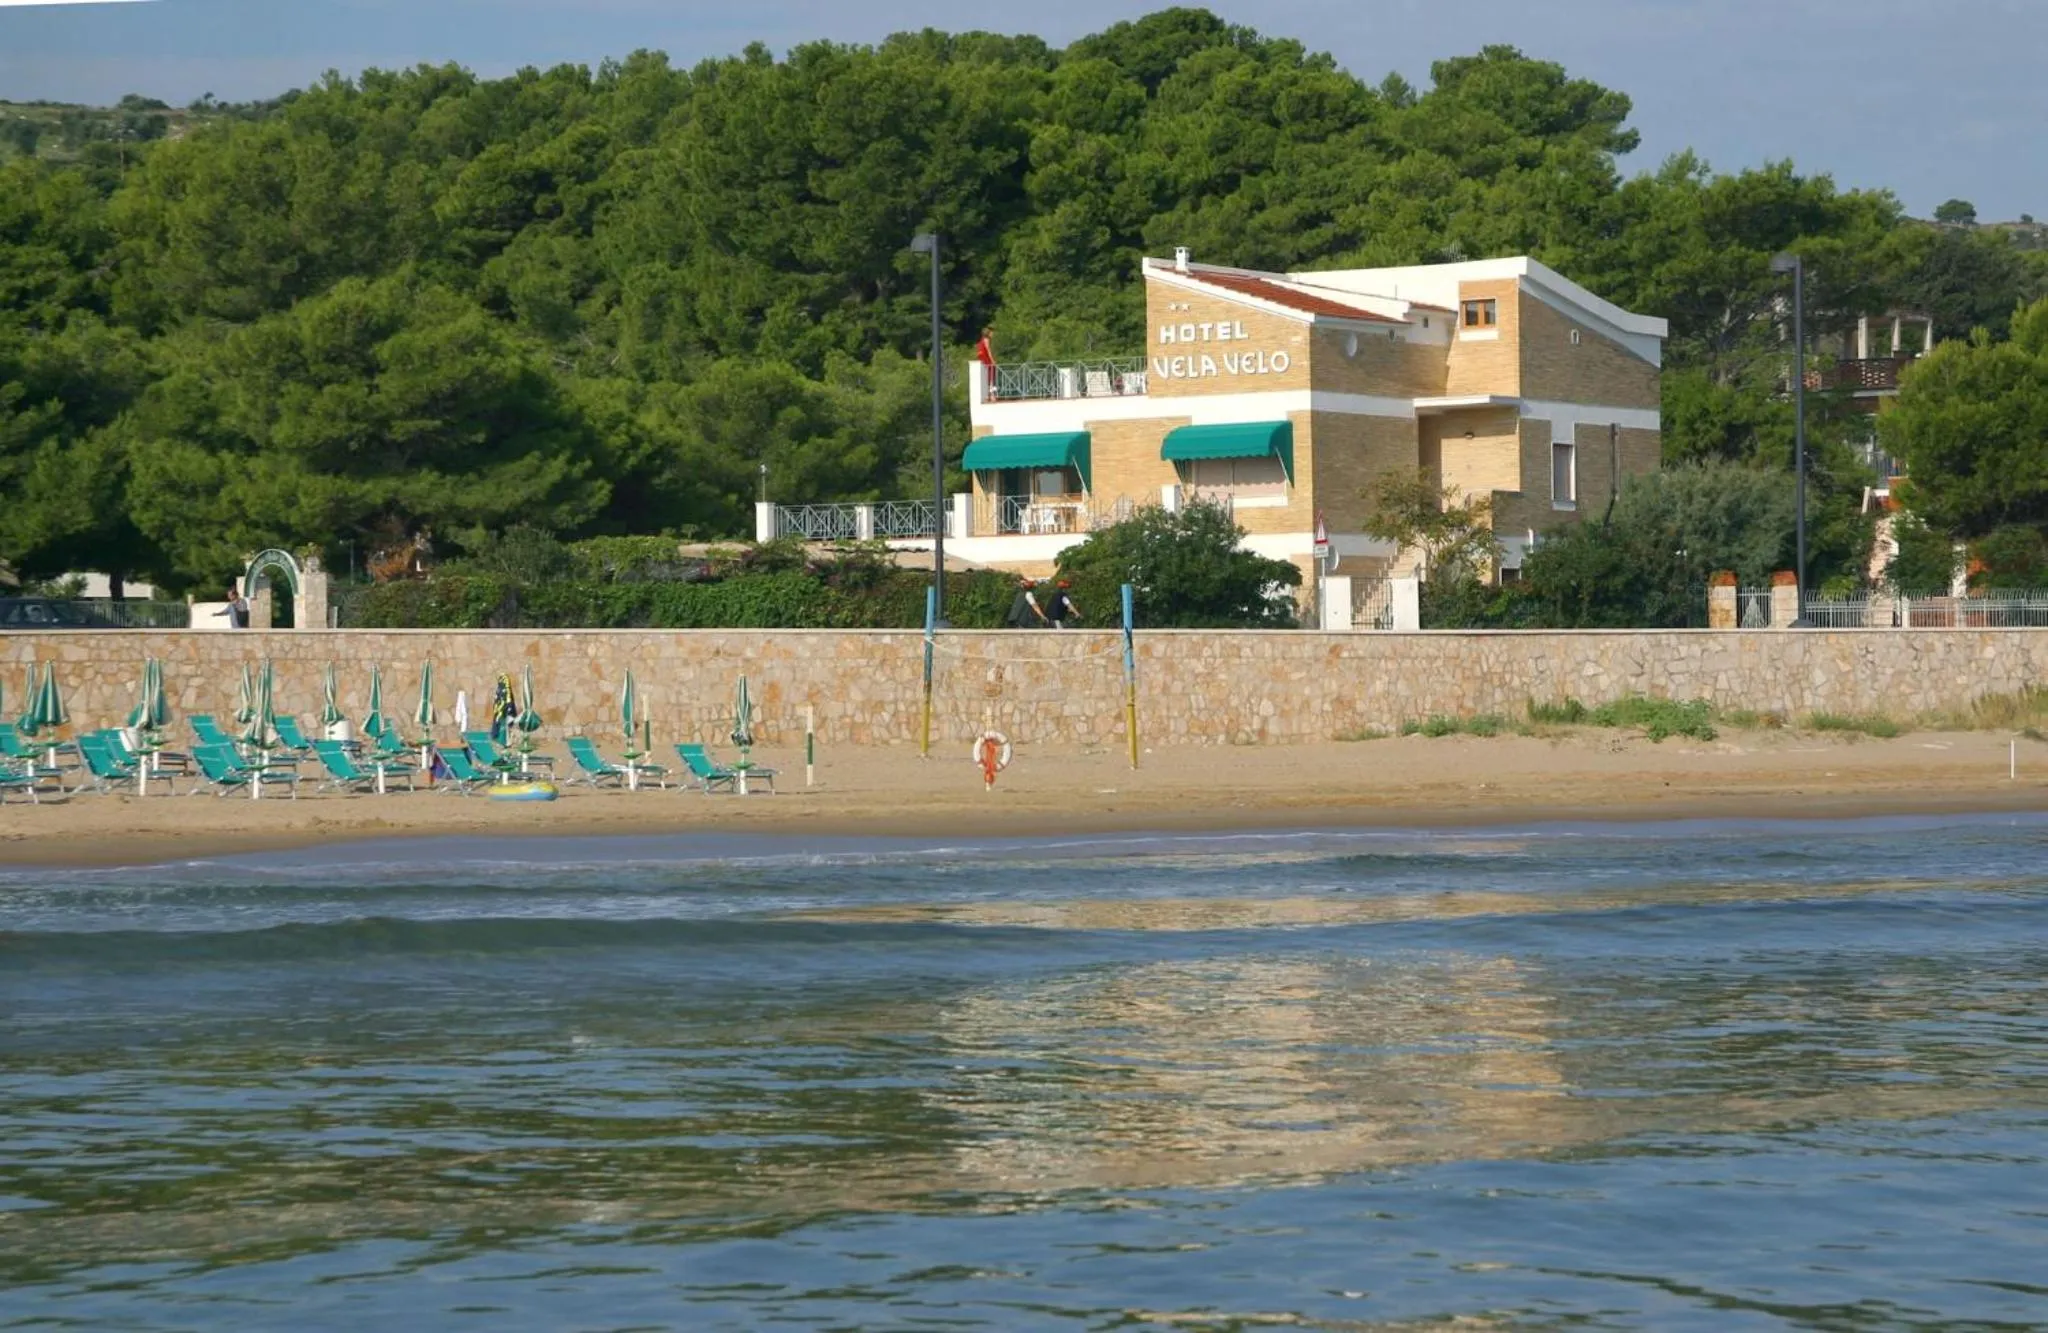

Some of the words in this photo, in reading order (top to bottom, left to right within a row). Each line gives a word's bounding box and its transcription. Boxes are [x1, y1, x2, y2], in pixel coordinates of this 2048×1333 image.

[1160, 320, 1249, 344] HOTEL
[1153, 355, 1218, 379] VELA
[1223, 350, 1290, 375] VELO
